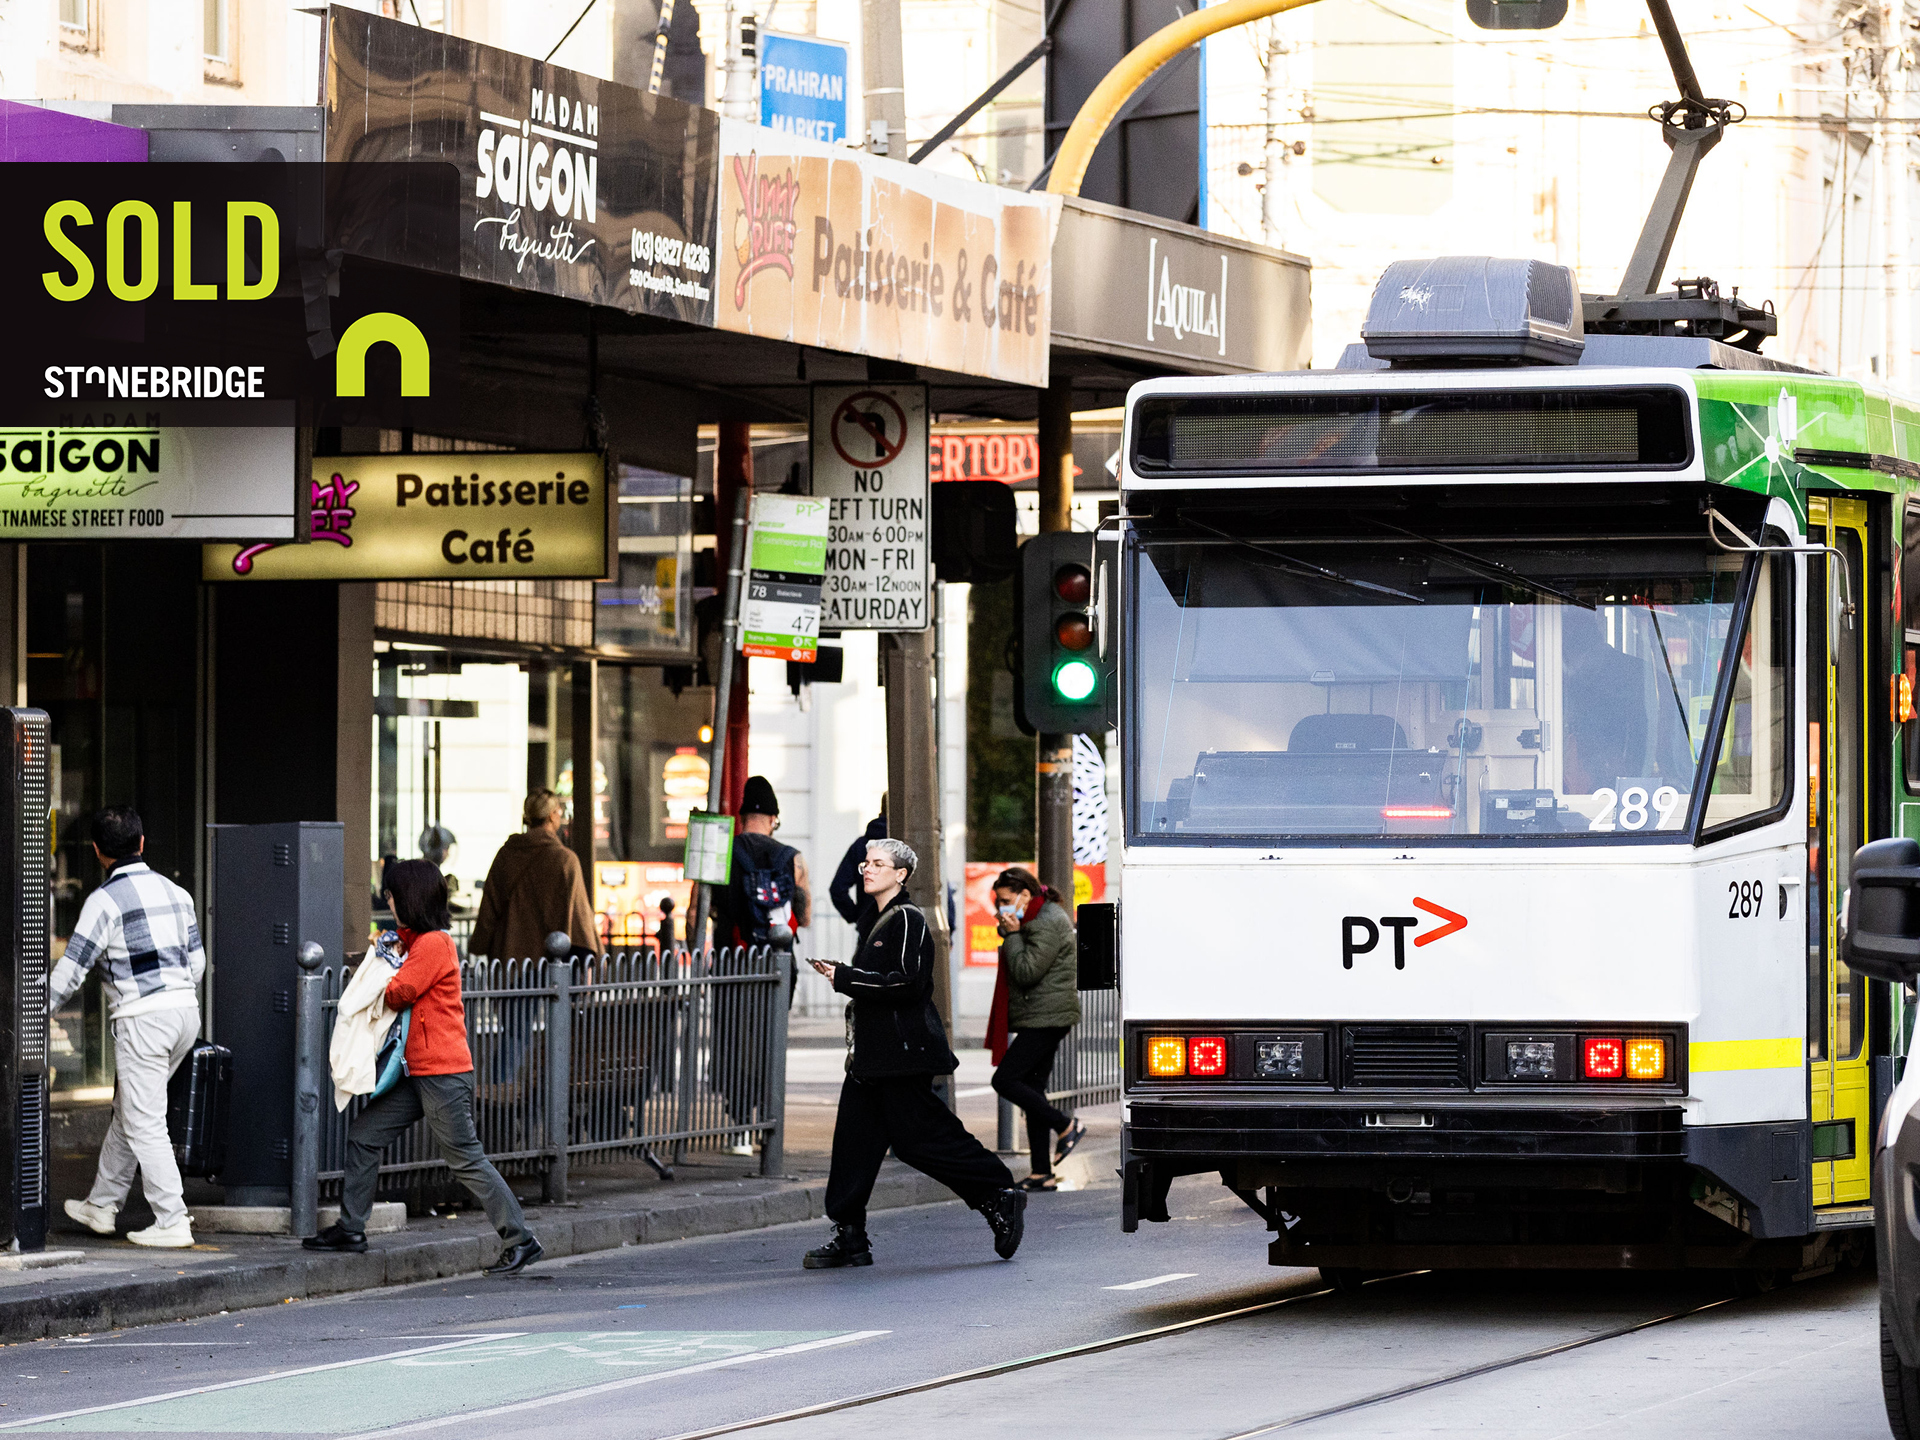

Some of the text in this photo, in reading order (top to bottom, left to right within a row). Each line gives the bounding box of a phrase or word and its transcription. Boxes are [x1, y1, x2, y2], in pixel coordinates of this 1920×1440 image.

[765, 64, 843, 102] PRAHRAN
[531, 88, 598, 136] MADAM
[771, 113, 837, 144] MARKET
[474, 208, 596, 273] baguette
[631, 228, 711, 274] (03) 9827 4236
[629, 268, 643, 287] 350
[643, 271, 666, 294] Chapel
[675, 277, 694, 298] South
[693, 281, 710, 302] Yarra
[812, 216, 1038, 337] Patisserie & Café
[0, 430, 160, 473] aiGON
[395, 472, 590, 507] Patisserie
[855, 470, 883, 493] NO
[0, 509, 164, 527] TNAMESE STREET FOOD
[829, 499, 923, 520] EFT TURN
[441, 527, 535, 565] Café
[810, 539, 823, 548] Rd
[825, 549, 866, 570] MON
[883, 549, 914, 570] FRI
[752, 585, 768, 598] 78
[791, 616, 815, 633] 47
[1589, 785, 1679, 831] 289
[1728, 879, 1764, 919] 289
